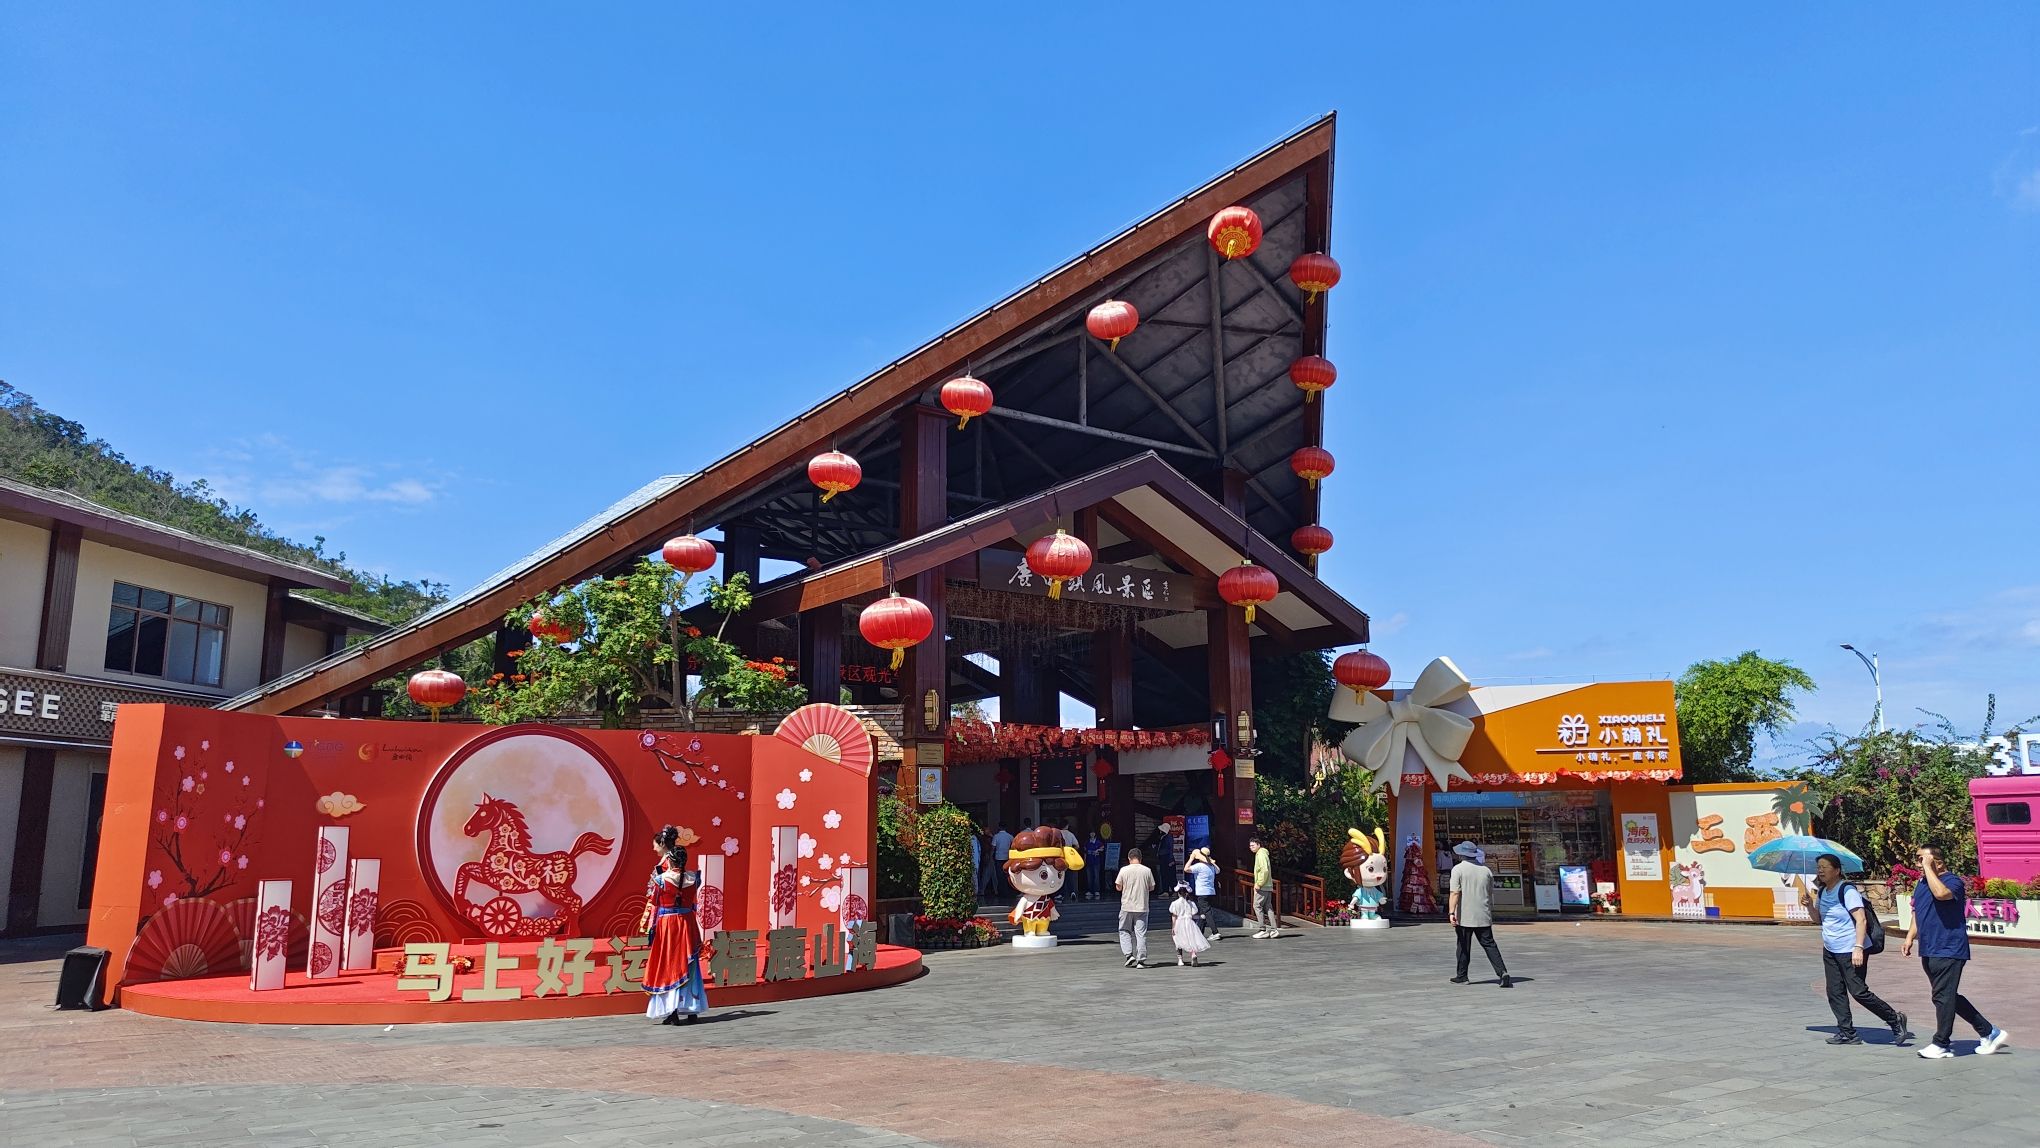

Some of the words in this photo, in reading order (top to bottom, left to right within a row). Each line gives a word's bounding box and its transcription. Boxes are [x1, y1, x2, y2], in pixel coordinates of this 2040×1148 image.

[1598, 714, 1666, 725] XIAOQUELI
[1598, 726, 1669, 745] 小确礼
[540, 859, 569, 884] 福
[397, 935, 651, 1003] 马上好运
[709, 920, 878, 987] 福鹿山海
